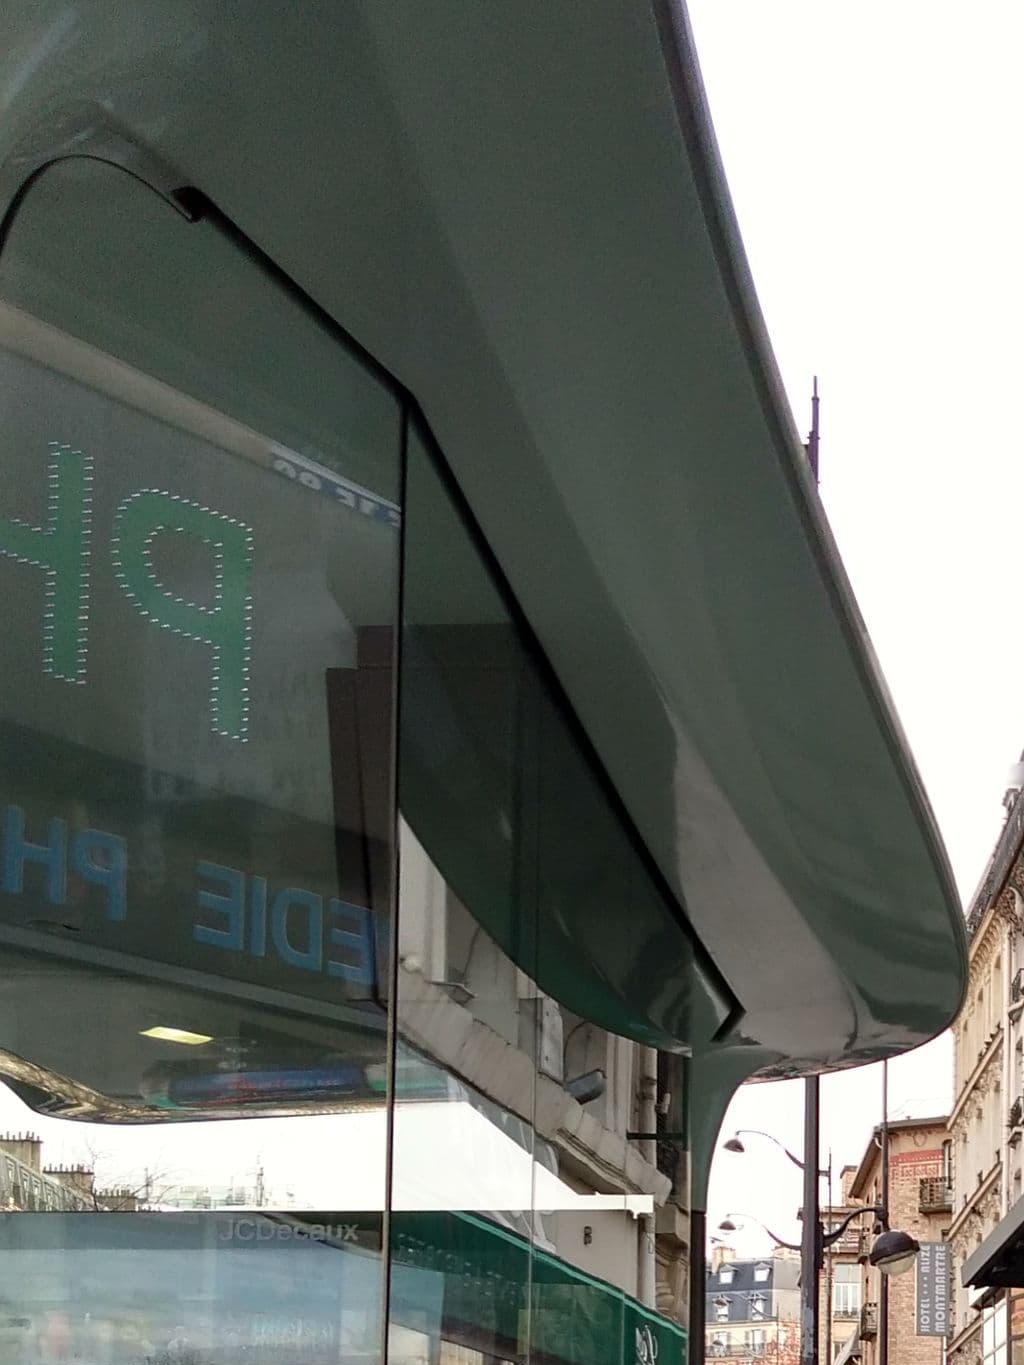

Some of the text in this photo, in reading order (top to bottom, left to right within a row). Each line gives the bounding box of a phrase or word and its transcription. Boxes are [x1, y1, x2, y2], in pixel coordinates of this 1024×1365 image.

[218, 1218, 359, 1242] JCDecaux
[935, 1245, 946, 1333] MONTMARTRE
[920, 1298, 932, 1332] HOTEL
